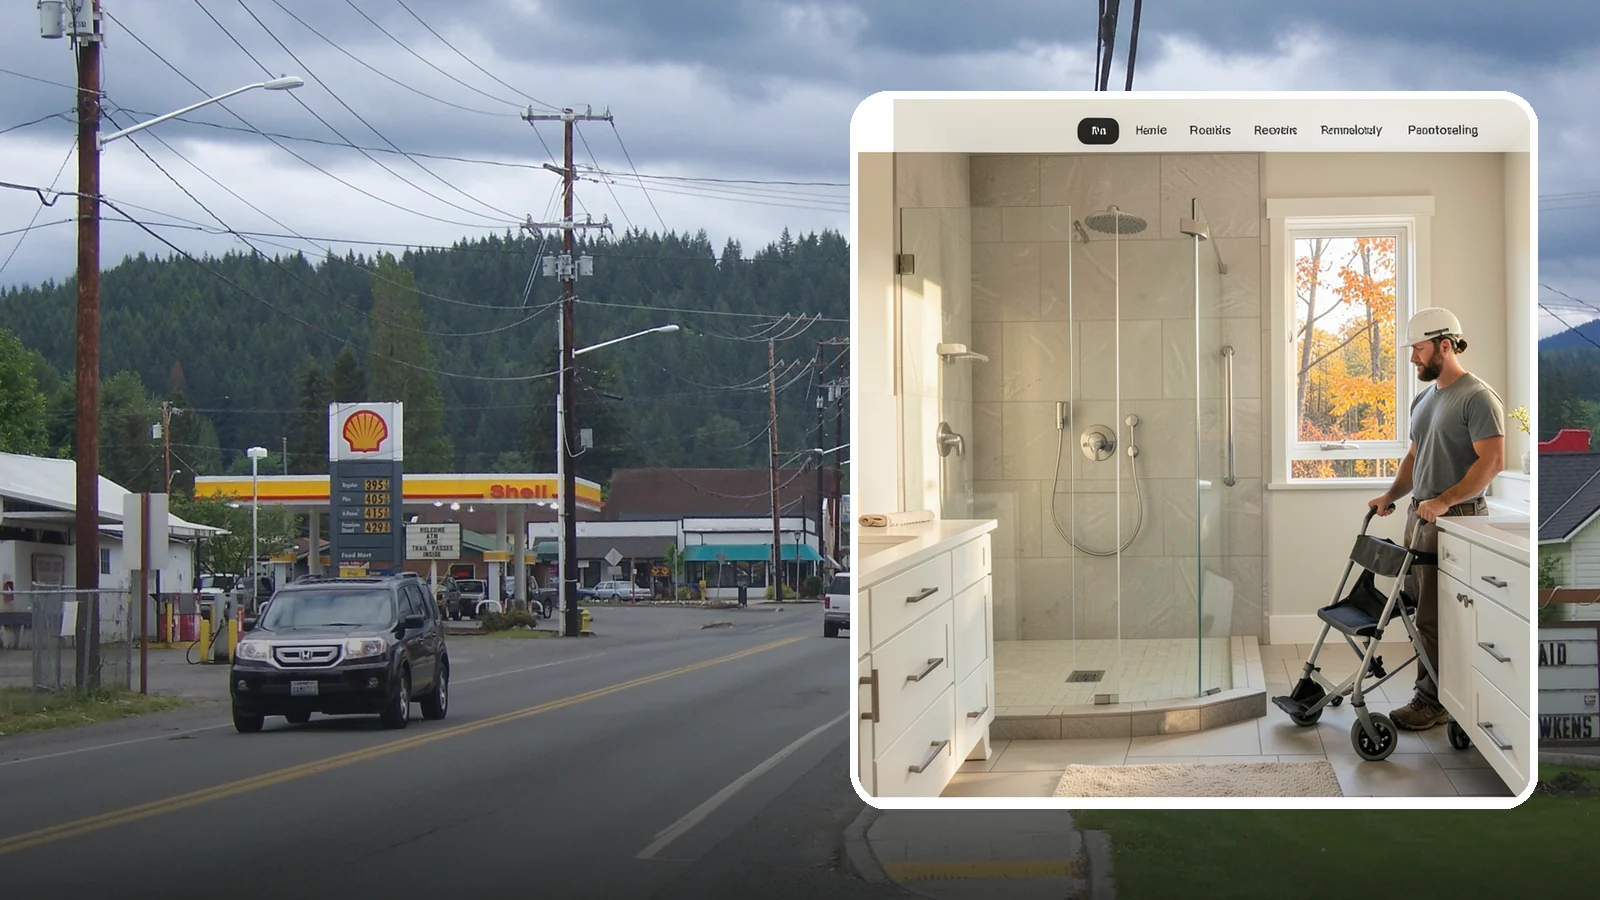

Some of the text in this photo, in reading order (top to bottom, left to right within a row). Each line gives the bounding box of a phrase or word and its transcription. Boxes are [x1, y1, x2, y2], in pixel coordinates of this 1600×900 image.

[365, 480, 384, 490] 395
[490, 484, 547, 499] Shell
[365, 494, 384, 504] 405
[365, 508, 384, 518] 415
[366, 523, 384, 533] 429
